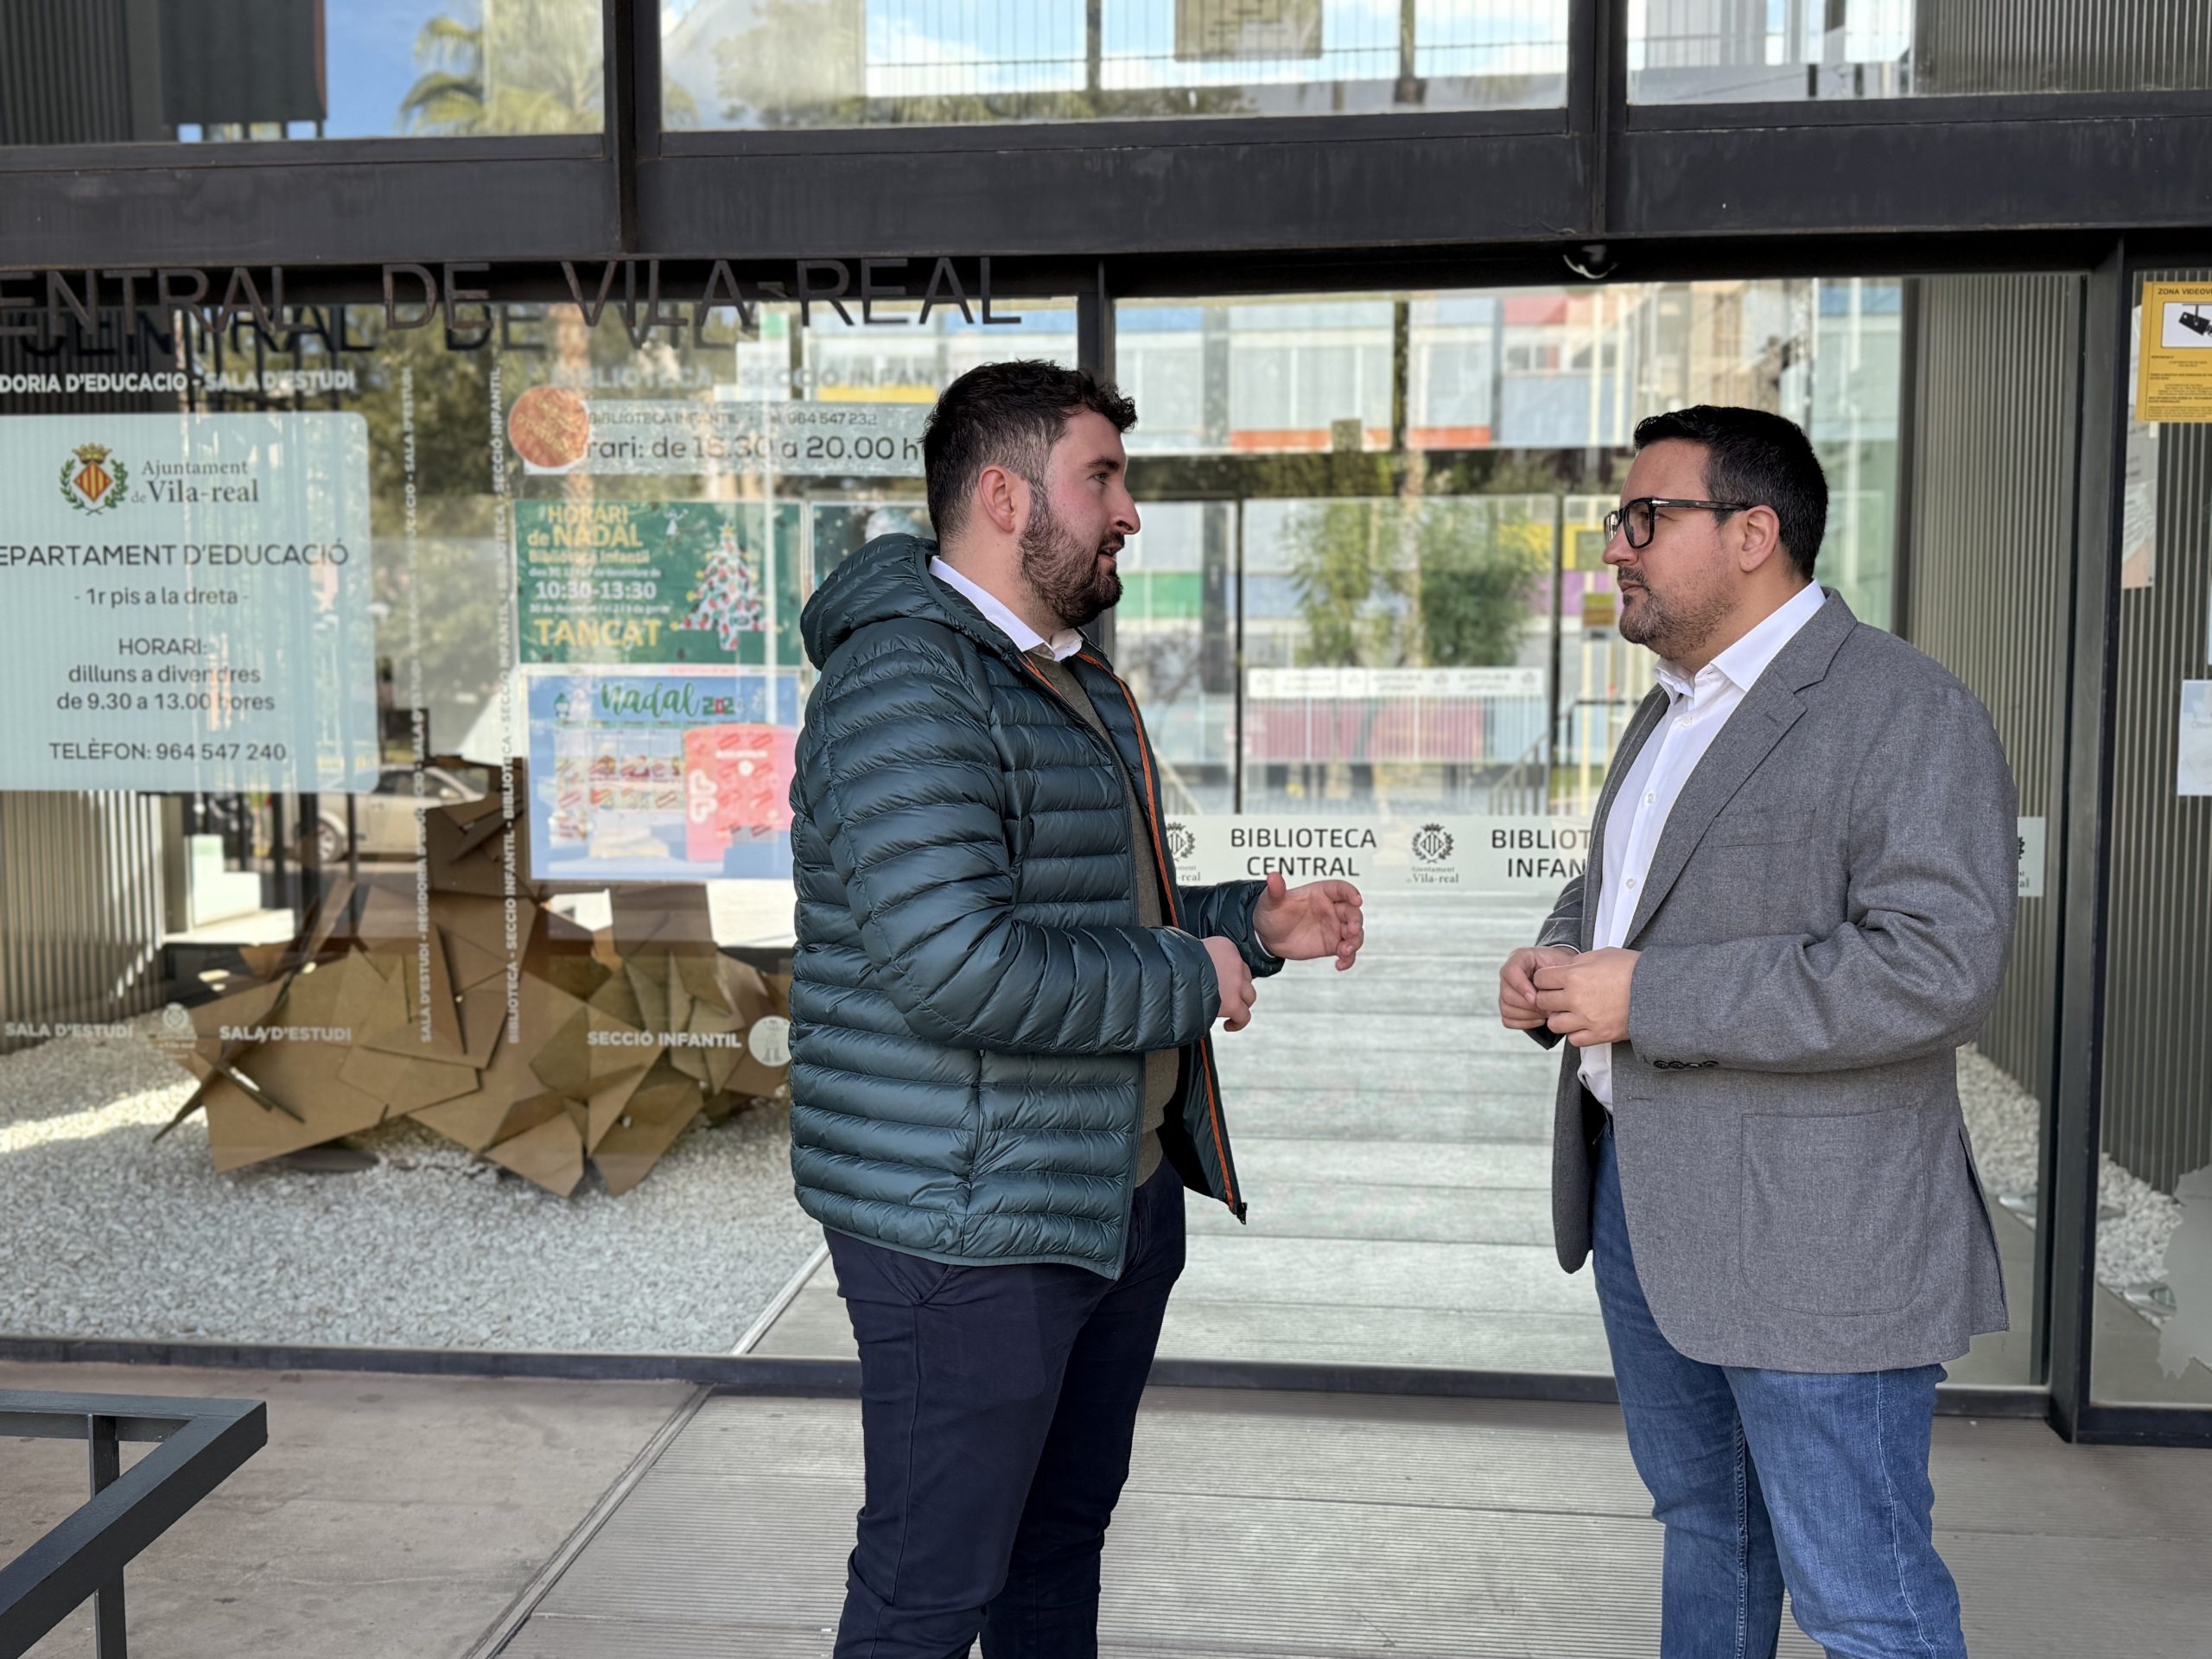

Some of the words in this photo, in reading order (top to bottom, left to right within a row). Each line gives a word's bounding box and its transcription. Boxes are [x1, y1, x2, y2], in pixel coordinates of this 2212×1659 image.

[382, 262, 494, 330] DE
[560, 257, 1022, 327] VILA-REAL
[0, 373, 61, 393] DORIA
[204, 372, 259, 391] SALA
[490, 367, 503, 435] INFANTIL
[788, 412, 817, 425] 964
[820, 412, 846, 425] 547
[849, 413, 877, 425] 232
[404, 433, 416, 473] SALA
[652, 436, 686, 458] de
[781, 440, 798, 459] a
[806, 435, 895, 460] 20.00
[141, 460, 248, 478] Ajuntament
[130, 491, 146, 504] de
[146, 478, 259, 504] Vila-real
[526, 529, 550, 547] de
[552, 523, 645, 548] NADAL
[183, 537, 350, 566] D'EDUCACIÓ
[86, 588, 107, 605] 1r
[111, 588, 142, 608] pis
[145, 592, 158, 605] a
[162, 588, 180, 605] la
[183, 588, 239, 605] dreta
[535, 581, 658, 600] 10:30-13:30
[533, 619, 663, 647] TANCAT
[118, 638, 208, 655] HORARI:
[68, 664, 137, 683] dilluns
[141, 670, 153, 683] a
[158, 664, 261, 683] divendres
[56, 692, 83, 710] de
[87, 692, 132, 710] 9.30
[136, 696, 149, 710] a
[154, 692, 212, 710] 13.00
[218, 692, 276, 710] hores
[49, 737, 152, 760] TELÈFON:
[156, 742, 196, 760] 964
[200, 742, 241, 760] 547
[245, 742, 287, 760] 240
[502, 736, 514, 819] BIBLIOTECA
[1230, 828, 1377, 849] BIBLIOTECA
[504, 828, 515, 893] INFANTIL
[1246, 855, 1361, 877] CENTRAL
[1412, 873, 1459, 884] Vila-real
[416, 868, 429, 934] REGIDORIA
[418, 942, 430, 1005] D'ESTUDI
[507, 963, 519, 1044] BIBLIOTECA
[4, 1022, 51, 1037] SALA
[54, 1022, 135, 1038] D'ESTUDI
[219, 1025, 267, 1041] SALA
[270, 1026, 353, 1042] D'ESTUDI
[422, 1008, 432, 1044] SALA
[588, 1028, 654, 1046] SECCIÓ
[658, 1032, 742, 1048] INFANTIL
